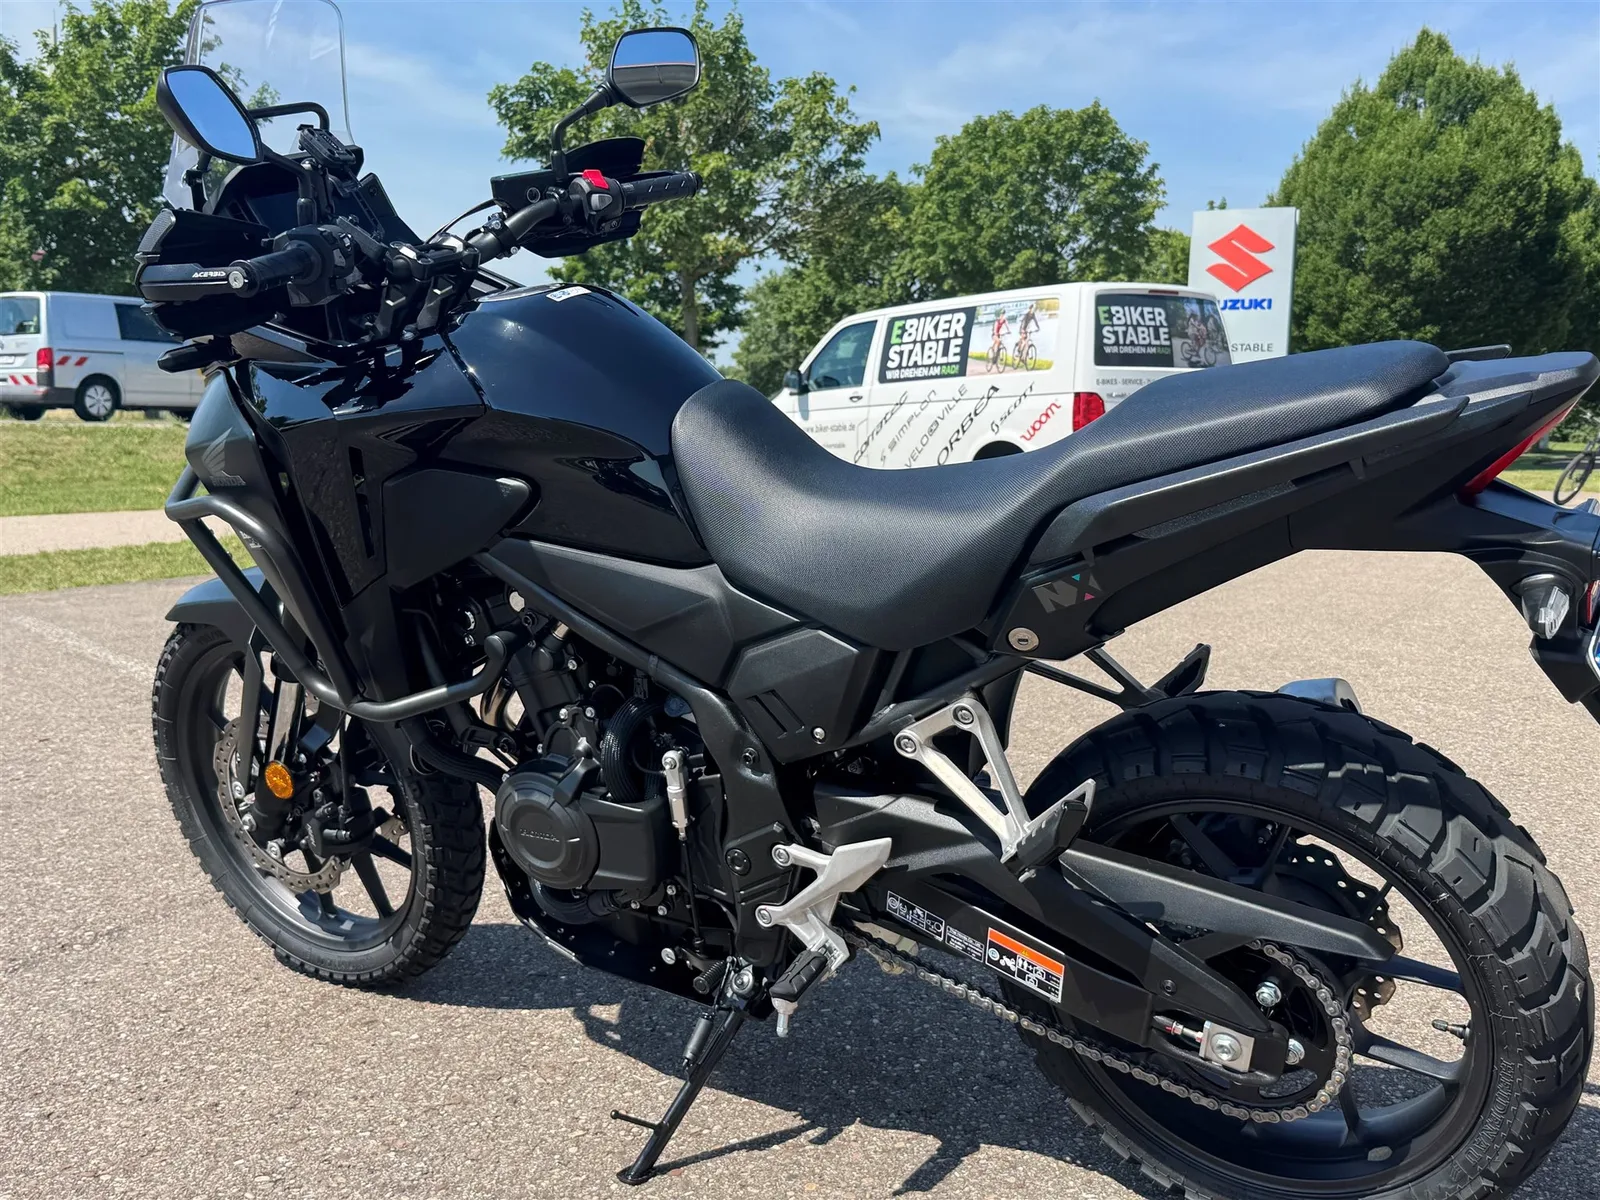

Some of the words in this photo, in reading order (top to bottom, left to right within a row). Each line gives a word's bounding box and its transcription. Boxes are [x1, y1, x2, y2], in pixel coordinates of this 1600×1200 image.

[1219, 298, 1273, 311] UZUKI
[1102, 326, 1171, 346] STABLE
[1231, 343, 1274, 353] STABLE
[886, 338, 963, 369] STABLE
[886, 369, 900, 380] WIR
[900, 367, 928, 379] DREHEN
[928, 366, 941, 377] AM
[999, 381, 1036, 426] SCOTT
[937, 385, 1000, 466] ORBEA
[1020, 401, 1062, 442] woom
